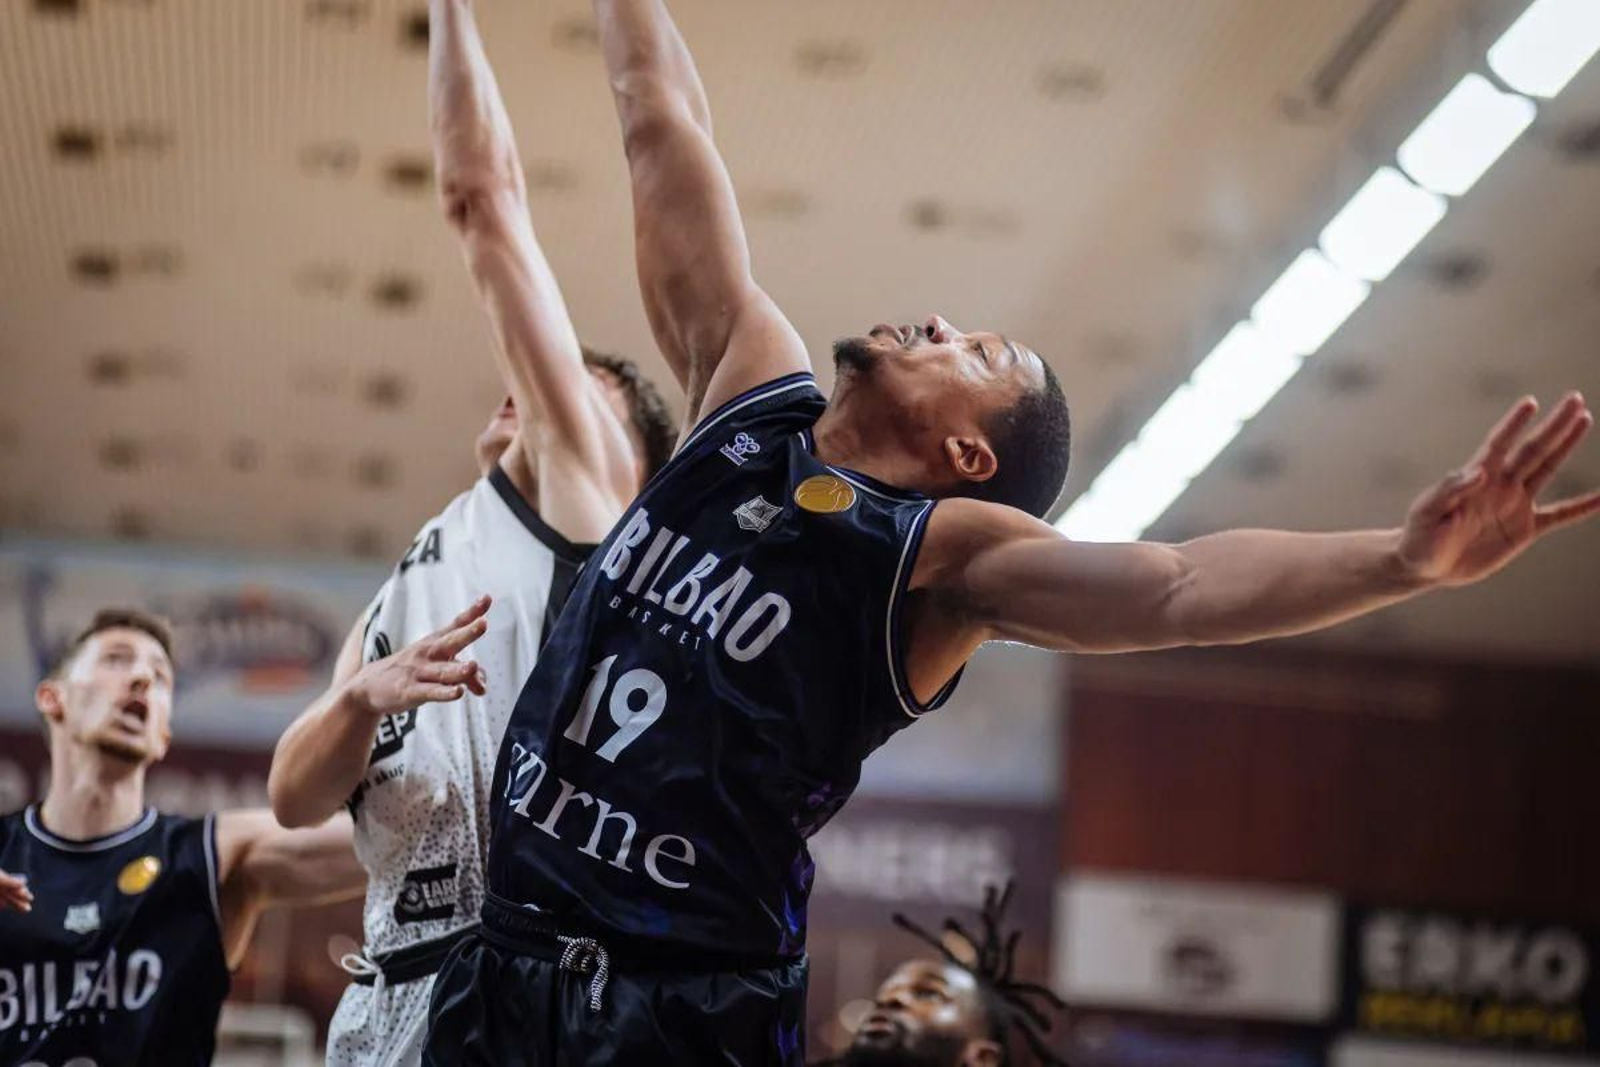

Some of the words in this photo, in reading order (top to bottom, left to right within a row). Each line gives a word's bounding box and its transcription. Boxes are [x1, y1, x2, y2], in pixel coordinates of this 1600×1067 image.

[600, 506, 793, 663] BILBAO
[608, 596, 701, 651] BASKET
[563, 654, 667, 763] 19
